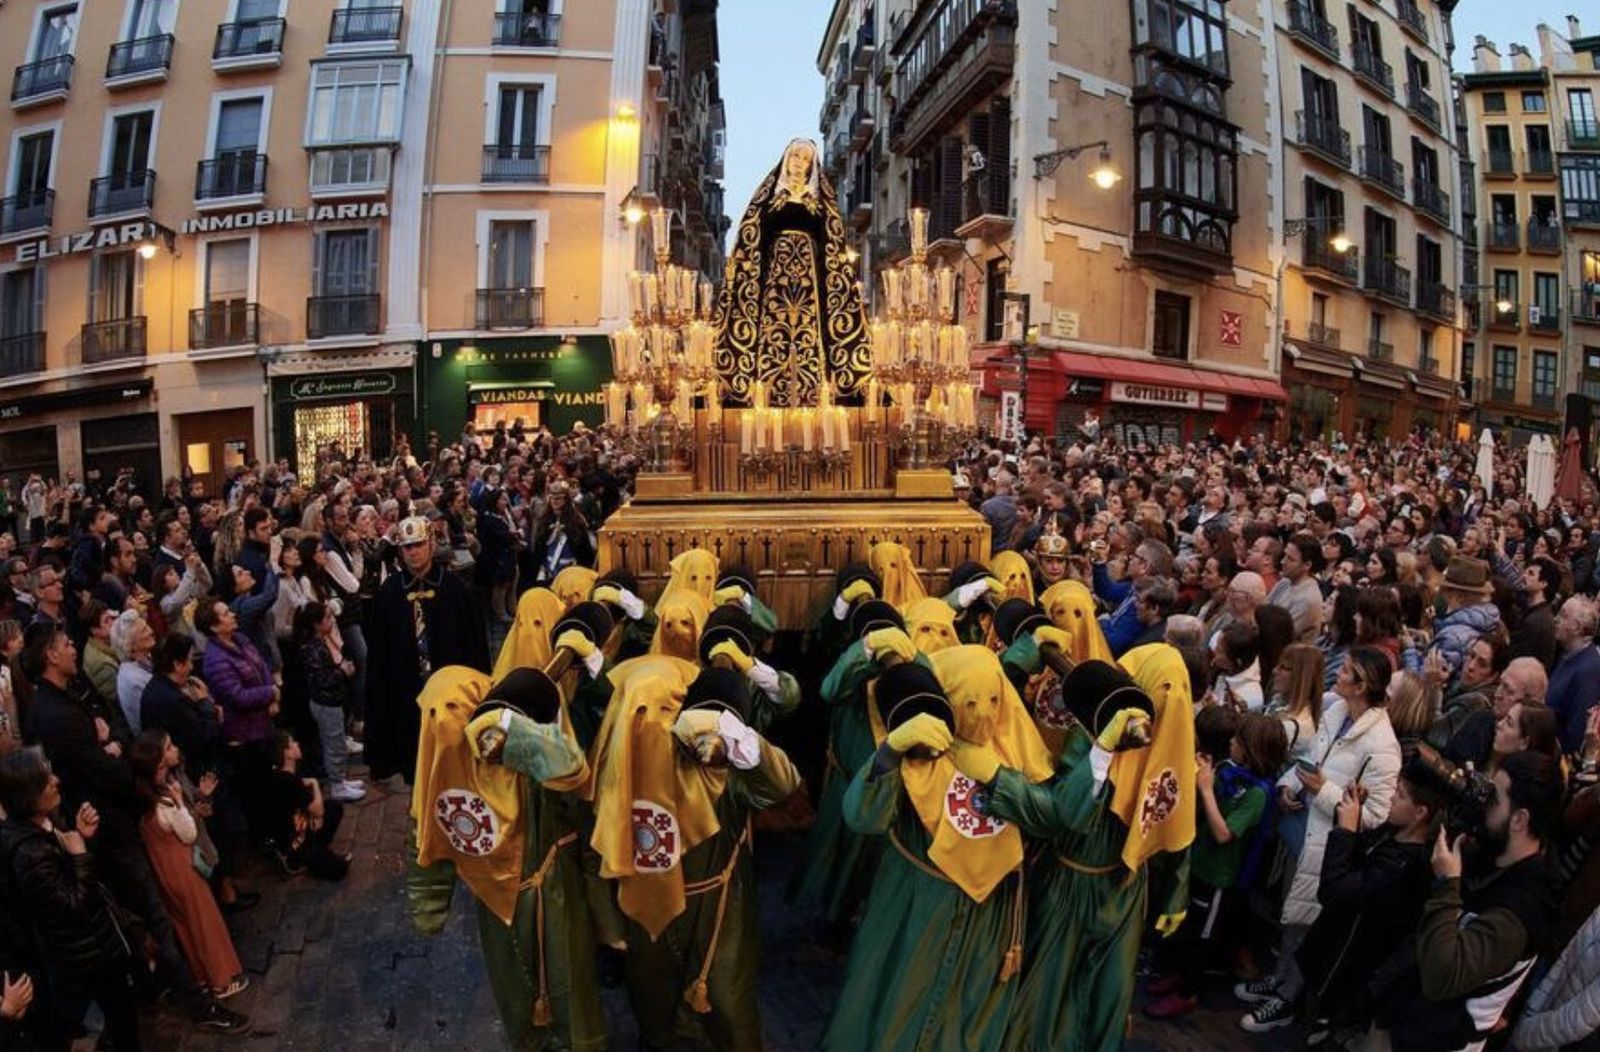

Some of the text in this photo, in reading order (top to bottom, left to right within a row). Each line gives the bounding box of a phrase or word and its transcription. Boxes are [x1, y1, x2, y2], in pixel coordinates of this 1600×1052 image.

[181, 202, 390, 234] INMOBILIARIA
[480, 390, 546, 402] VIANDAS
[1124, 384, 1189, 403] GUTIERREZ
